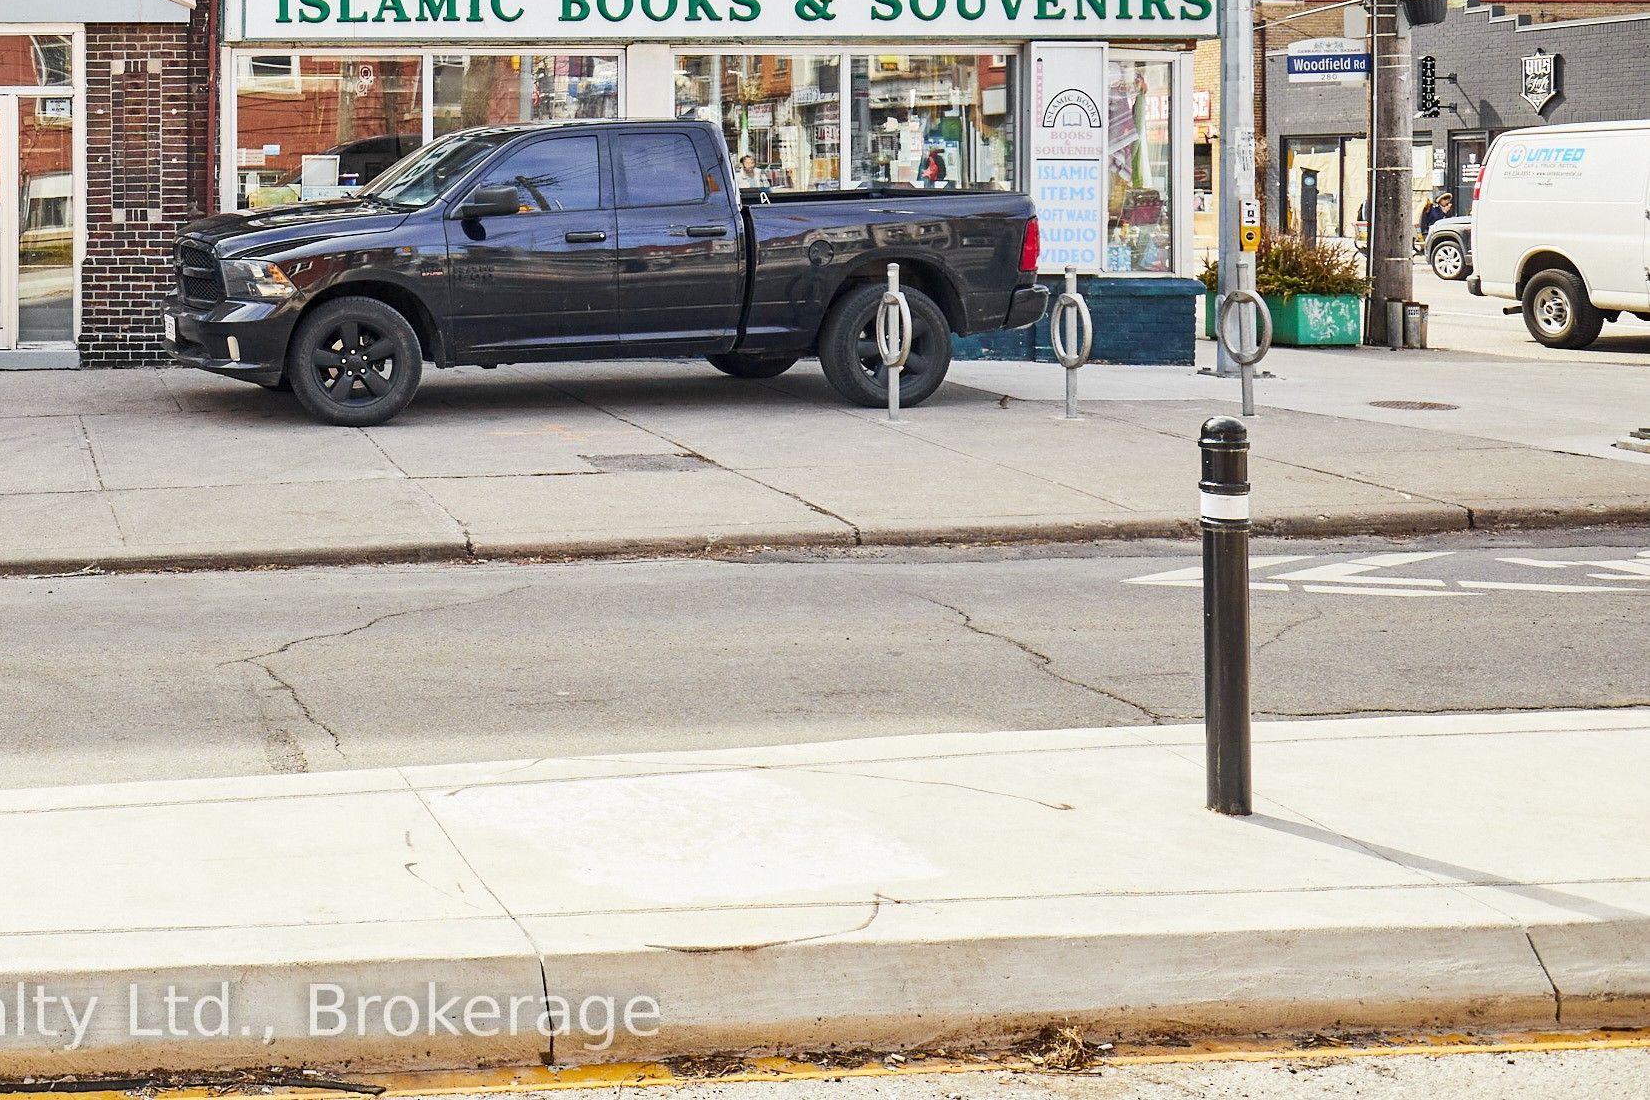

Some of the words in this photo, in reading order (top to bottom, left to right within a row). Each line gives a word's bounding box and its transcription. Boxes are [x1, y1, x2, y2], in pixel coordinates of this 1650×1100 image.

[1293, 58, 1351, 72] Woodfield
[1353, 59, 1366, 70] Rd
[1046, 94, 1074, 123] ISLAMIC
[1076, 95, 1098, 123] BOOKS
[1050, 131, 1093, 140] BOOKS
[1035, 146, 1103, 155] SOUVENIRS
[1526, 147, 1586, 162] UNITED
[1037, 165, 1099, 181] ISLAMIC
[1040, 186, 1096, 201] ITEMS
[1039, 227, 1098, 243] AUDIO
[1039, 249, 1096, 264] VIDEO
